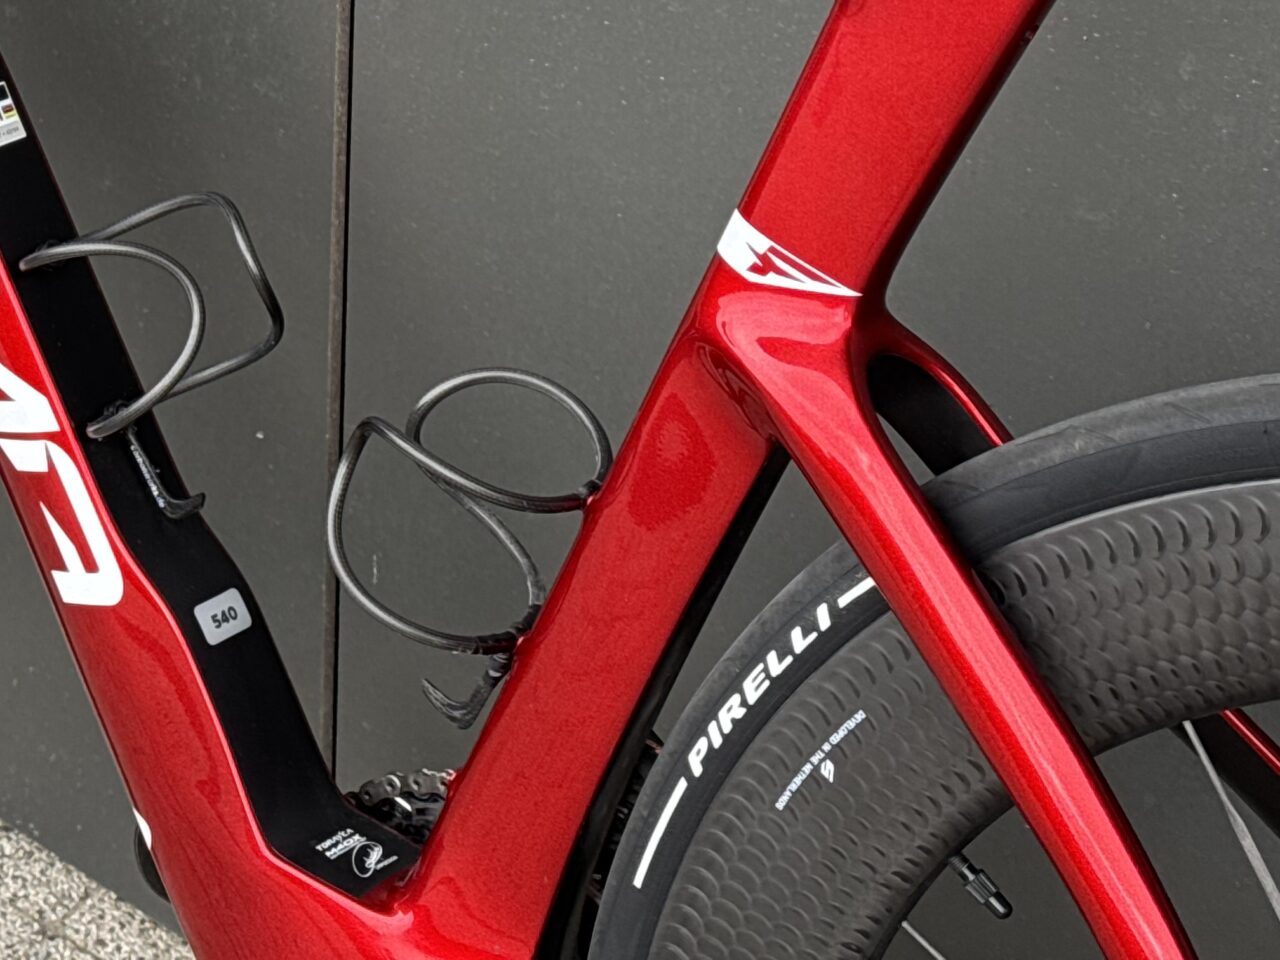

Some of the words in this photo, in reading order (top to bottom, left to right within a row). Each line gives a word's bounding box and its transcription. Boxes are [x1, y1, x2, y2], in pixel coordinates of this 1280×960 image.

[210, 606, 238, 629] 540
[687, 602, 832, 778] PIRELLI
[829, 709, 867, 745] DEVELOPED
[809, 749, 825, 766] THE
[821, 742, 832, 753] IN
[774, 762, 814, 811] NETHERLANDS
